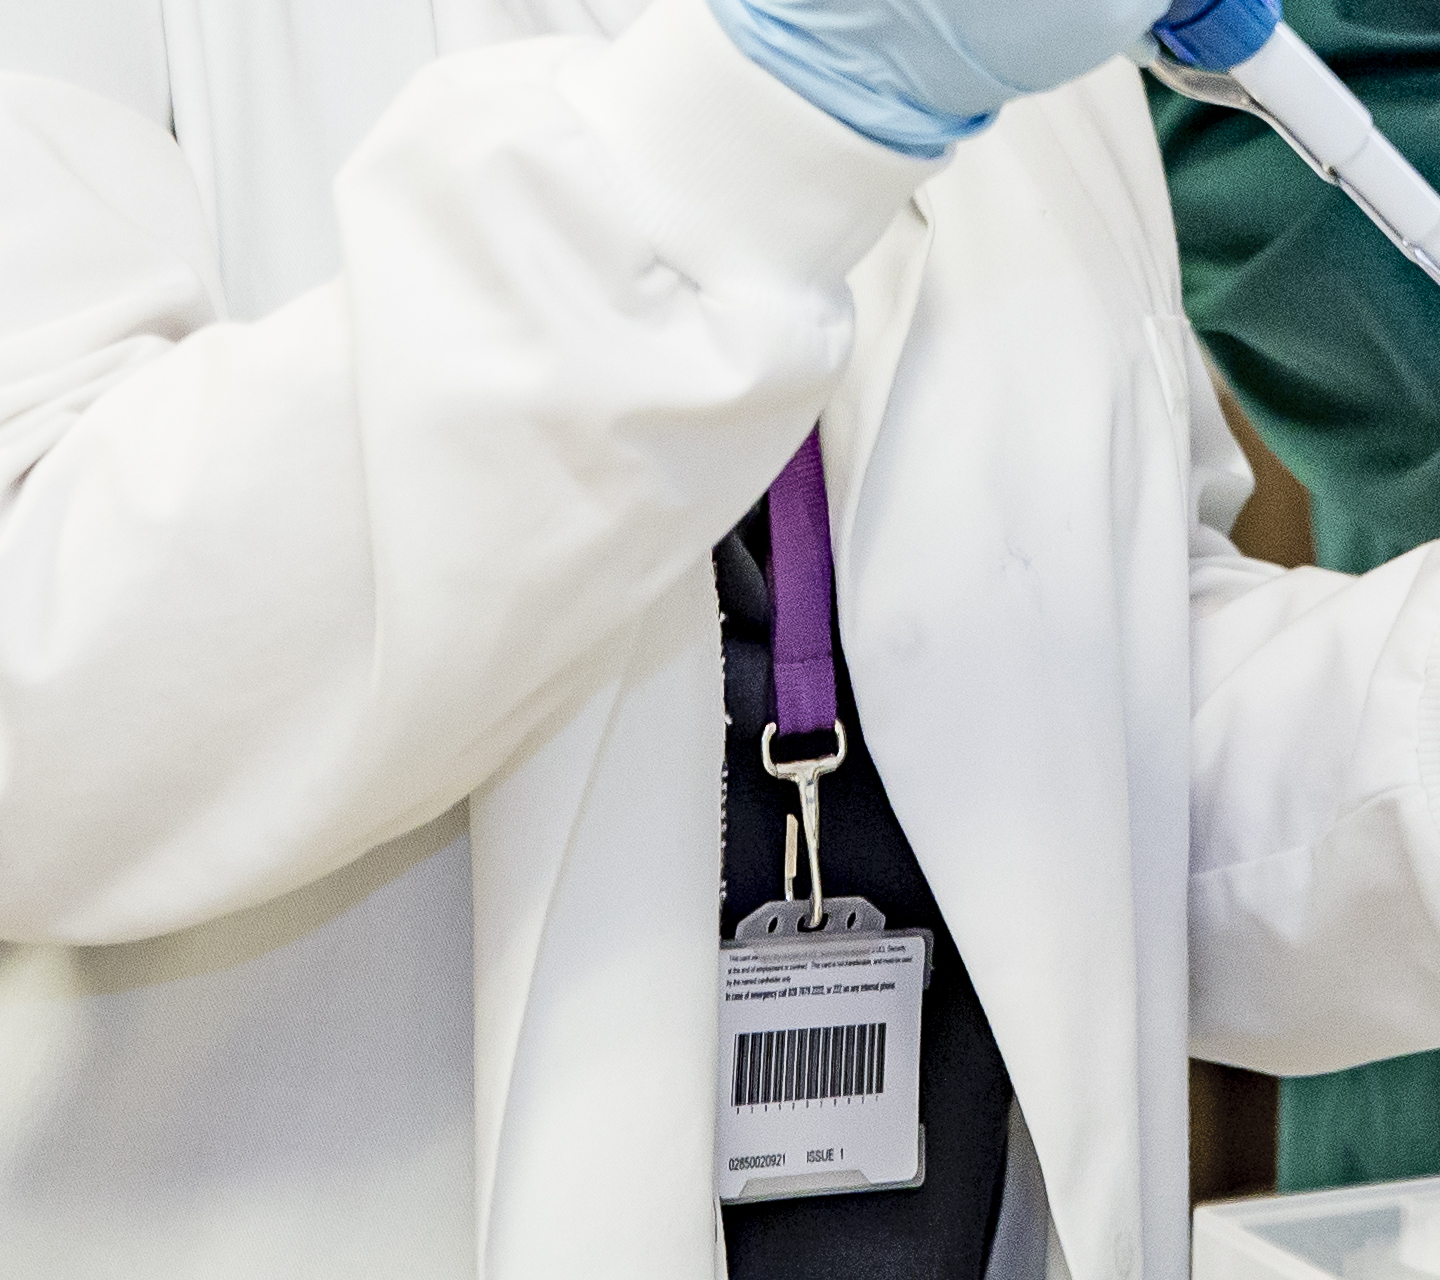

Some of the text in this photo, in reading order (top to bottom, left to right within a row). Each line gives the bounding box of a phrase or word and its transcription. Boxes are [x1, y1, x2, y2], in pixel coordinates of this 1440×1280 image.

[726, 992, 731, 1001] In
[732, 992, 743, 1001] case
[744, 990, 750, 1000] of
[751, 990, 777, 1001] emergency
[806, 1147, 834, 1163] ISSUE
[840, 1148, 844, 1160] 1
